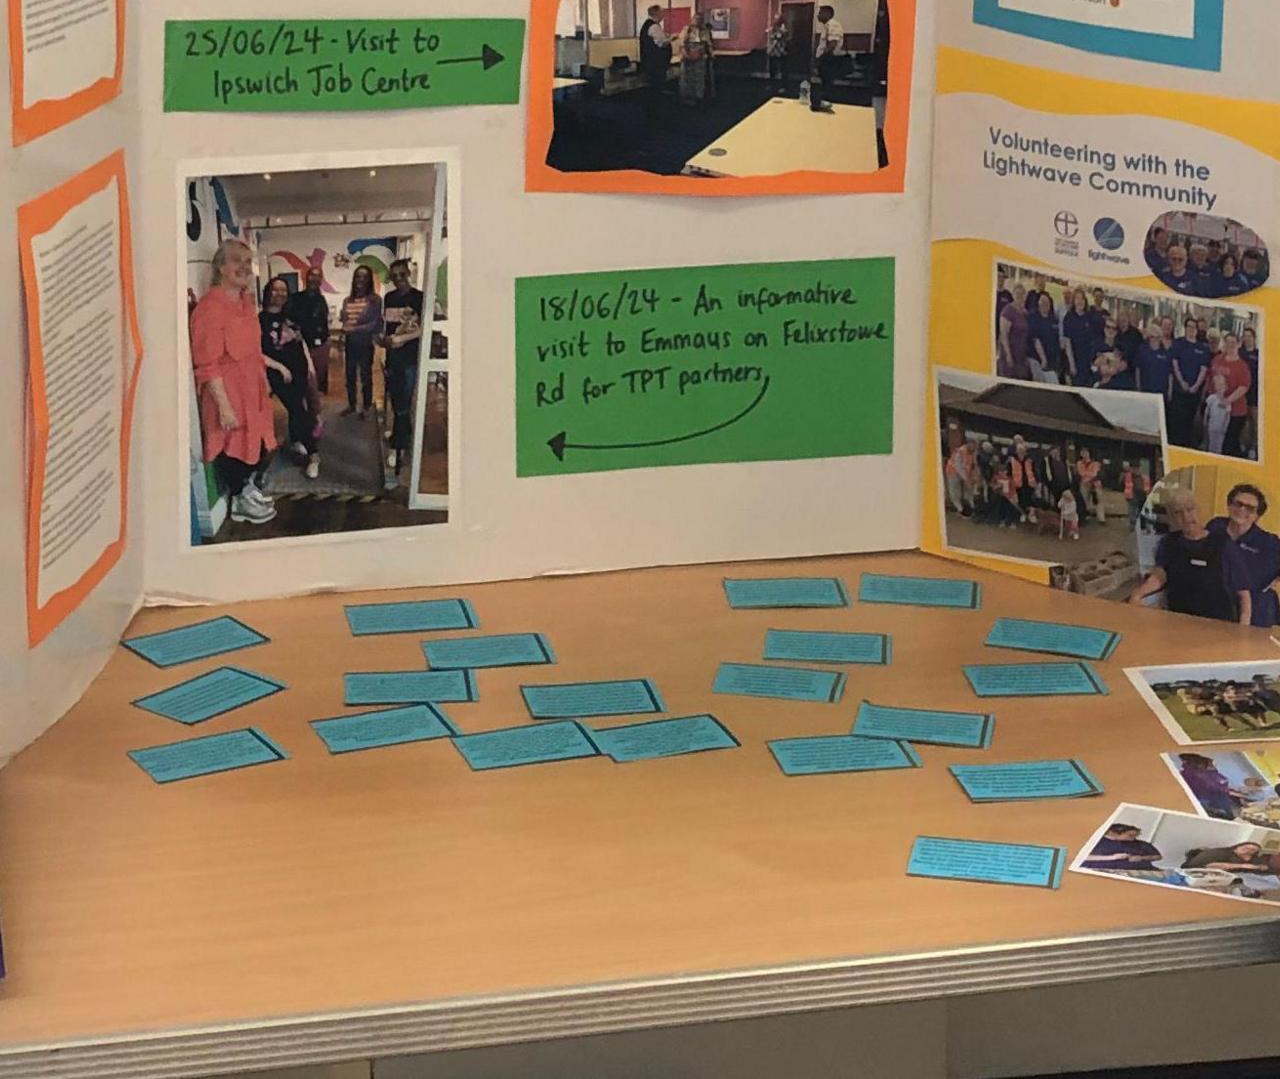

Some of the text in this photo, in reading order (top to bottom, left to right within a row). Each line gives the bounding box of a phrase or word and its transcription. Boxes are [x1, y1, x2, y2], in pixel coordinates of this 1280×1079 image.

[185, 23, 324, 58] 25/06/24
[346, 28, 400, 53] Visit
[414, 27, 440, 53] to
[213, 63, 431, 104] Ipswich Job Centre
[989, 126, 1210, 181] Volunteering with the
[983, 150, 1217, 211] Lightwave Community
[539, 282, 661, 321] 18/06/24
[693, 284, 723, 316] An
[737, 281, 858, 314] informative
[536, 320, 889, 362] visit to Emmaus on Felixstowe
[536, 372, 565, 408] Rd
[582, 382, 616, 404] for
[622, 366, 672, 394] TPT
